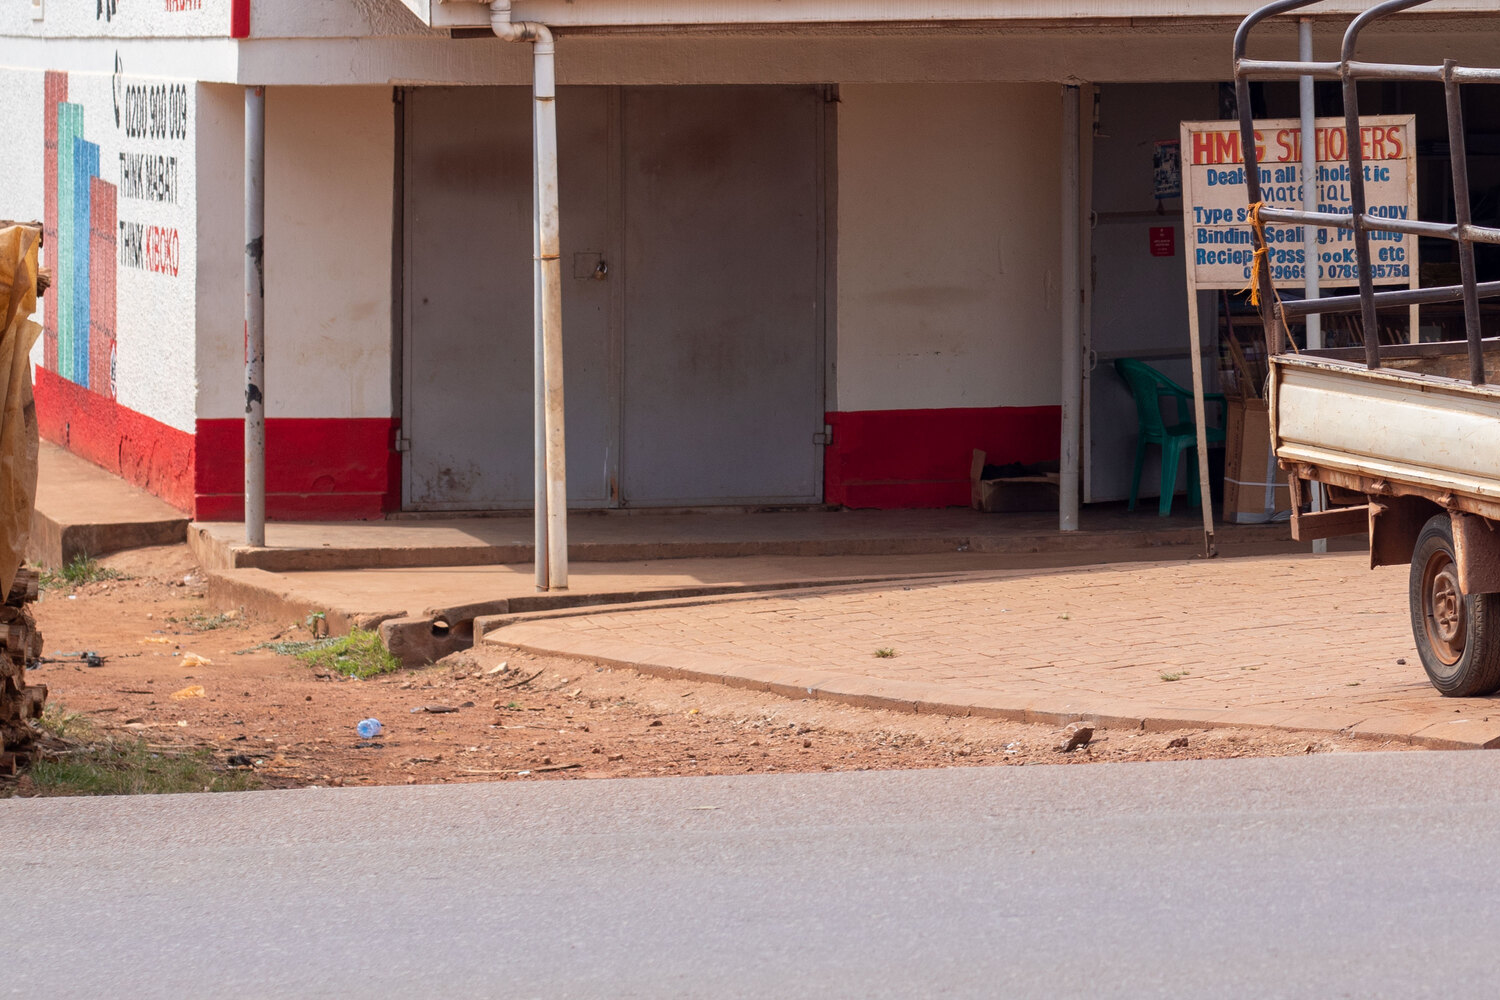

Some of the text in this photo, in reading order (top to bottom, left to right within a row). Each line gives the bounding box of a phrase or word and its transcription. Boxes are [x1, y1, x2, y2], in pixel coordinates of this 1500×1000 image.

[125, 83, 187, 140] 0200 900 009
[119, 152, 177, 204] THINK MABATI
[1275, 165, 1296, 183] all
[1193, 206, 1233, 224] Type
[119, 220, 180, 277] THINK KIBOKO
[1378, 246, 1405, 262] etc
